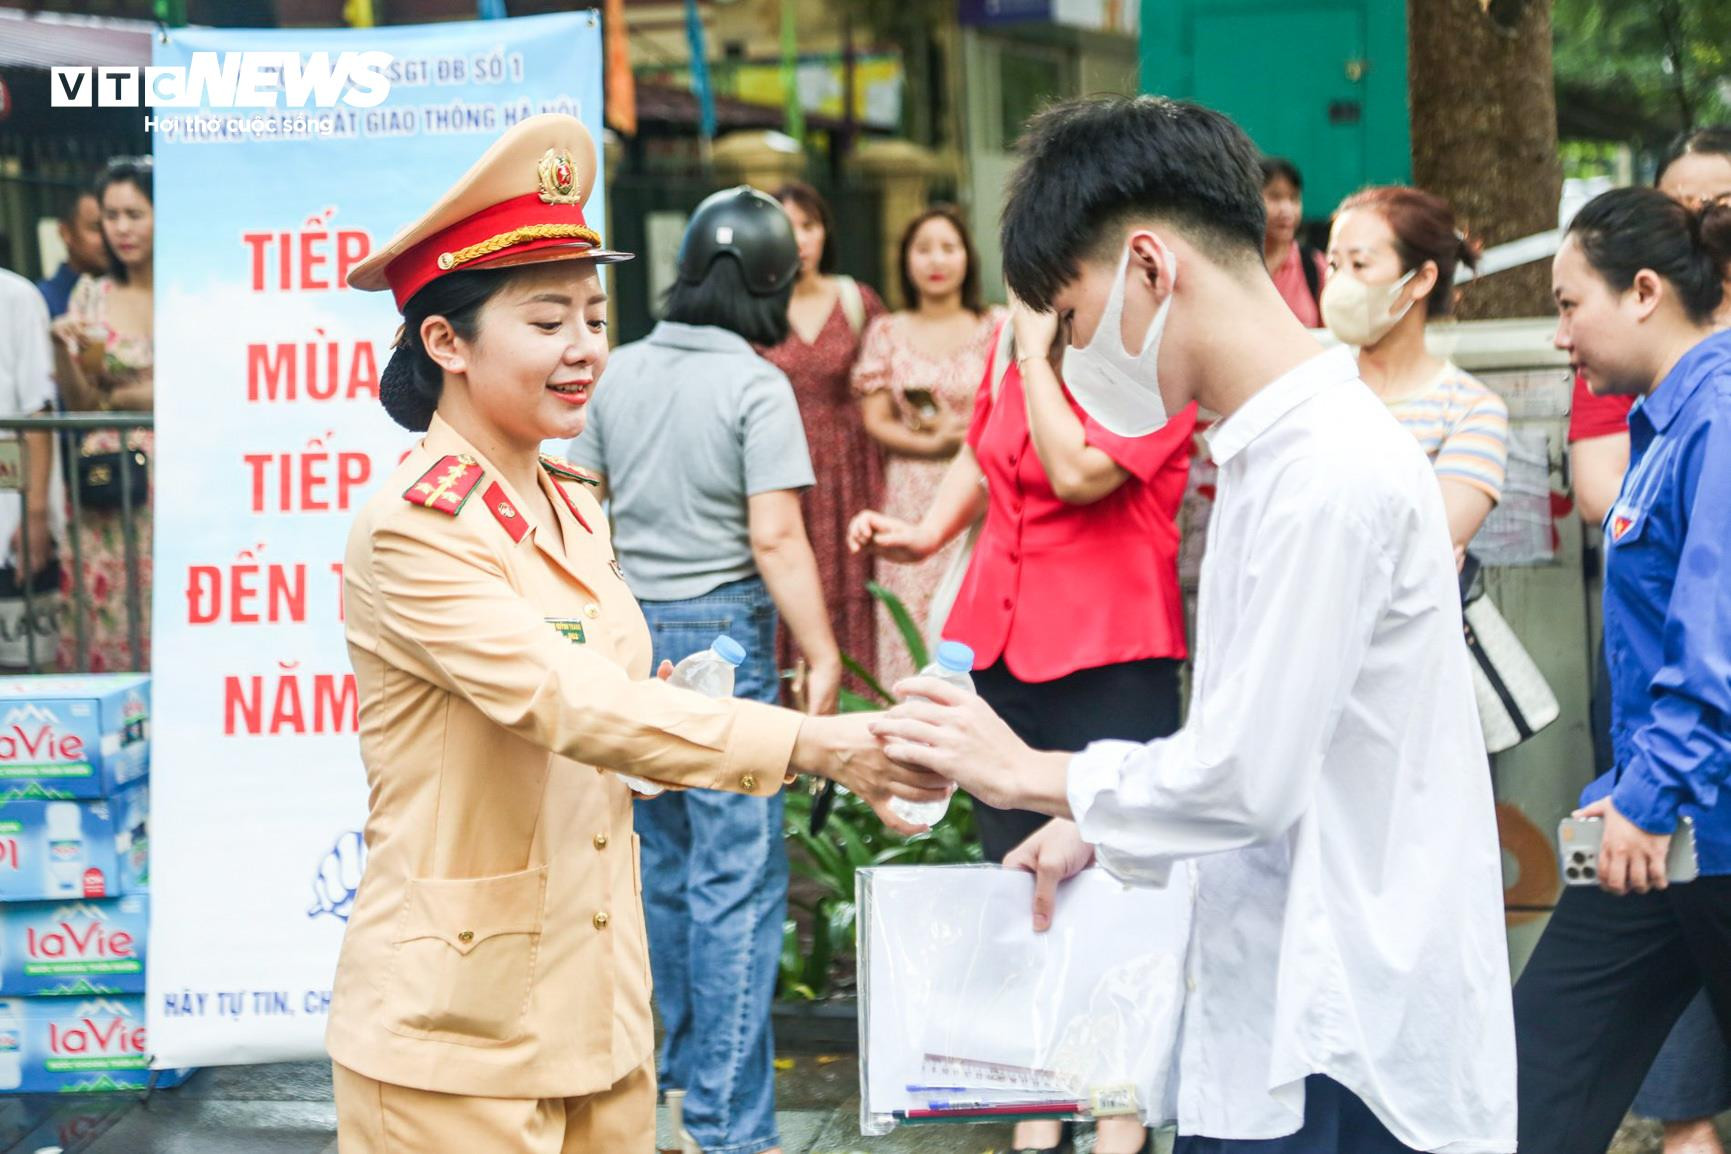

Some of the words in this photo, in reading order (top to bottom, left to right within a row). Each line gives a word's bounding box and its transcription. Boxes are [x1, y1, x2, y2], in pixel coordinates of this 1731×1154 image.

[513, 56, 521, 77] 1
[366, 110, 416, 134] GIAO
[425, 104, 497, 130] THÔNG
[243, 208, 371, 291] TIẾP
[247, 327, 380, 401] MÙA
[243, 430, 371, 512] TIẾP
[185, 543, 306, 625] ĐẾN
[223, 660, 359, 735] NĂM
[27, 920, 134, 958] laVie
